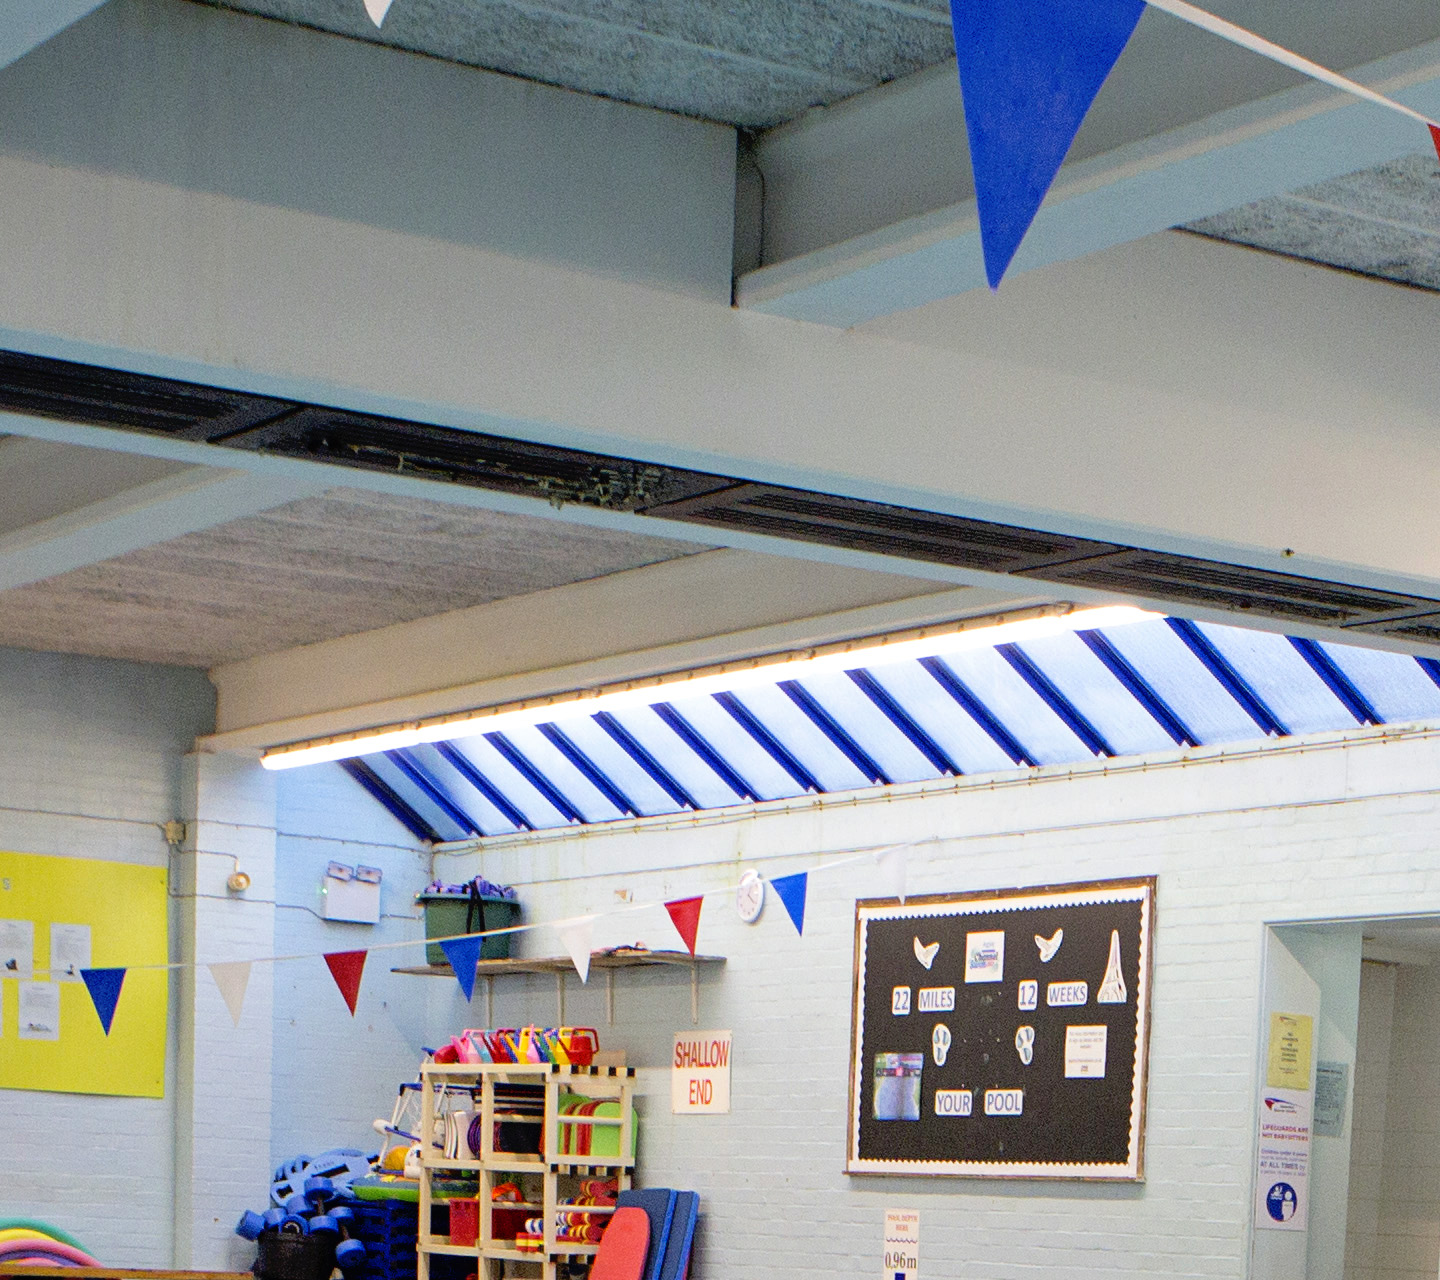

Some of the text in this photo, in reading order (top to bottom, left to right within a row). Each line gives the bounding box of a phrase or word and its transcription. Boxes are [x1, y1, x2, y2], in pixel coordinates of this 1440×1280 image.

[894, 990, 953, 1010] 22 MILES
[1020, 985, 1087, 1005] 12 WEEKS
[675, 1040, 730, 1069] SHALLOW
[688, 1079, 713, 1105] END
[937, 1093, 1021, 1113] YOUR POOL
